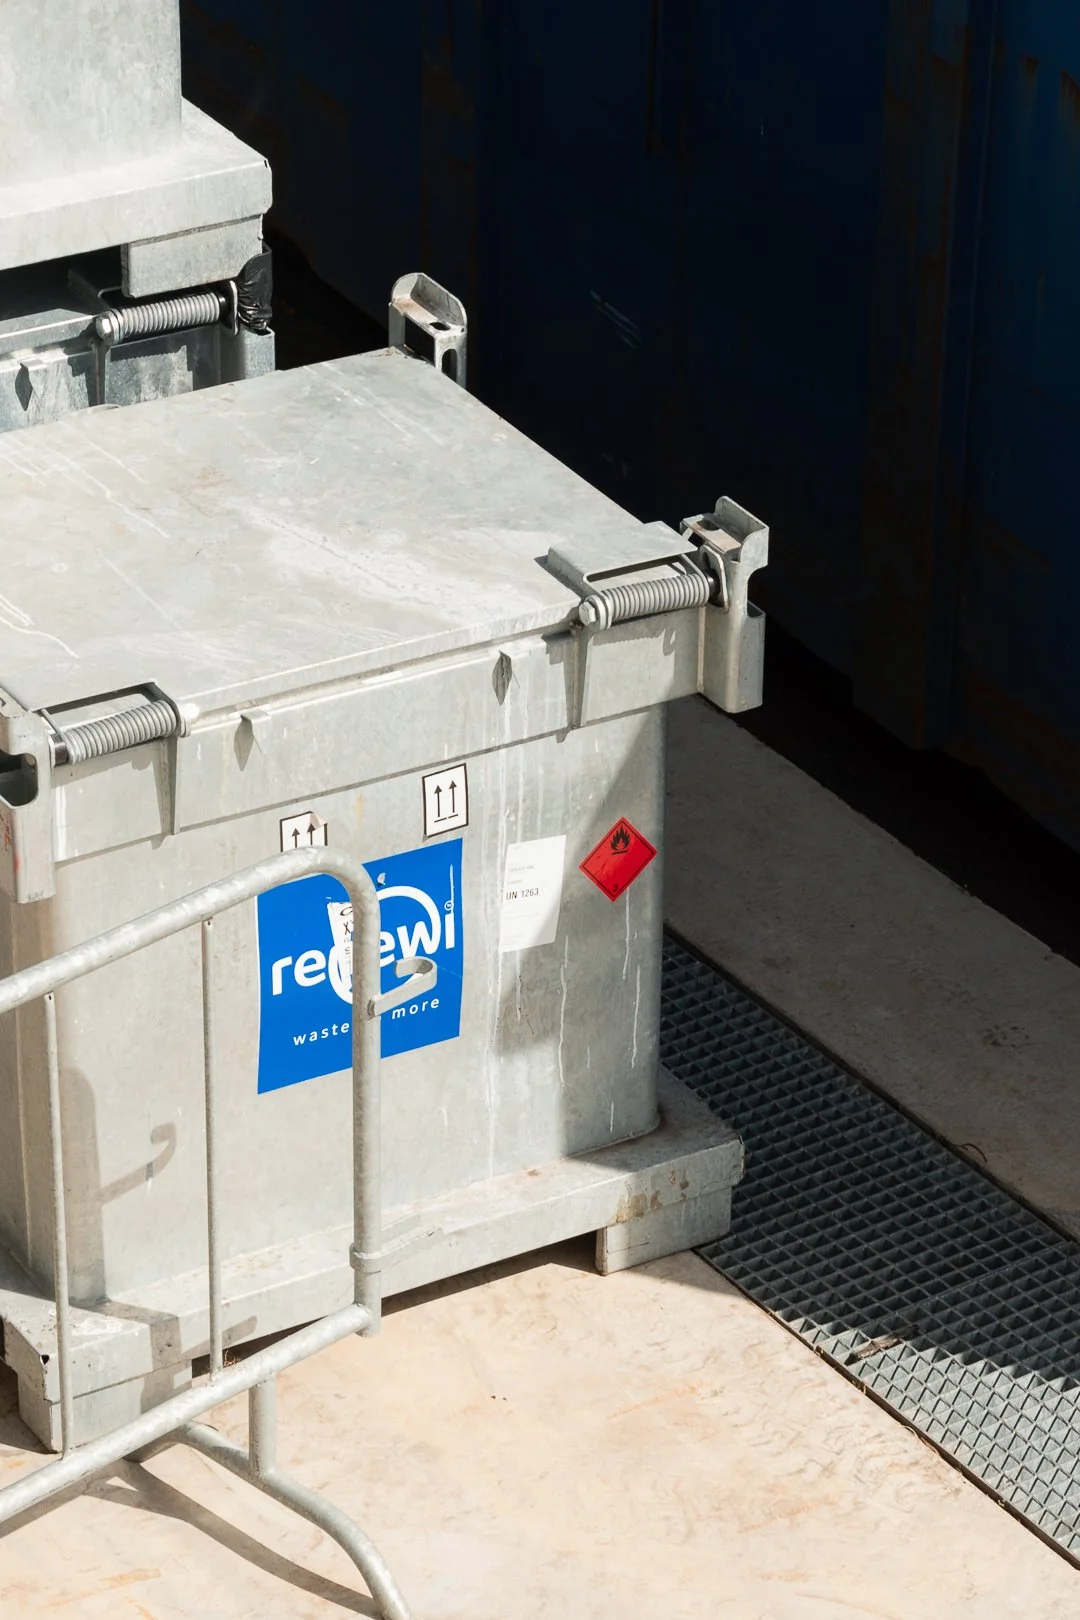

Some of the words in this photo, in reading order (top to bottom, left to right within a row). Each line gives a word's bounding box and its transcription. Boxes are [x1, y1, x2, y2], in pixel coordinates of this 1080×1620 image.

[506, 891, 518, 901] UN
[521, 887, 540, 898] 1263
[612, 883, 619, 893] 3
[272, 900, 455, 998] reewi
[293, 1022, 350, 1046] waste
[391, 998, 440, 1020] more
